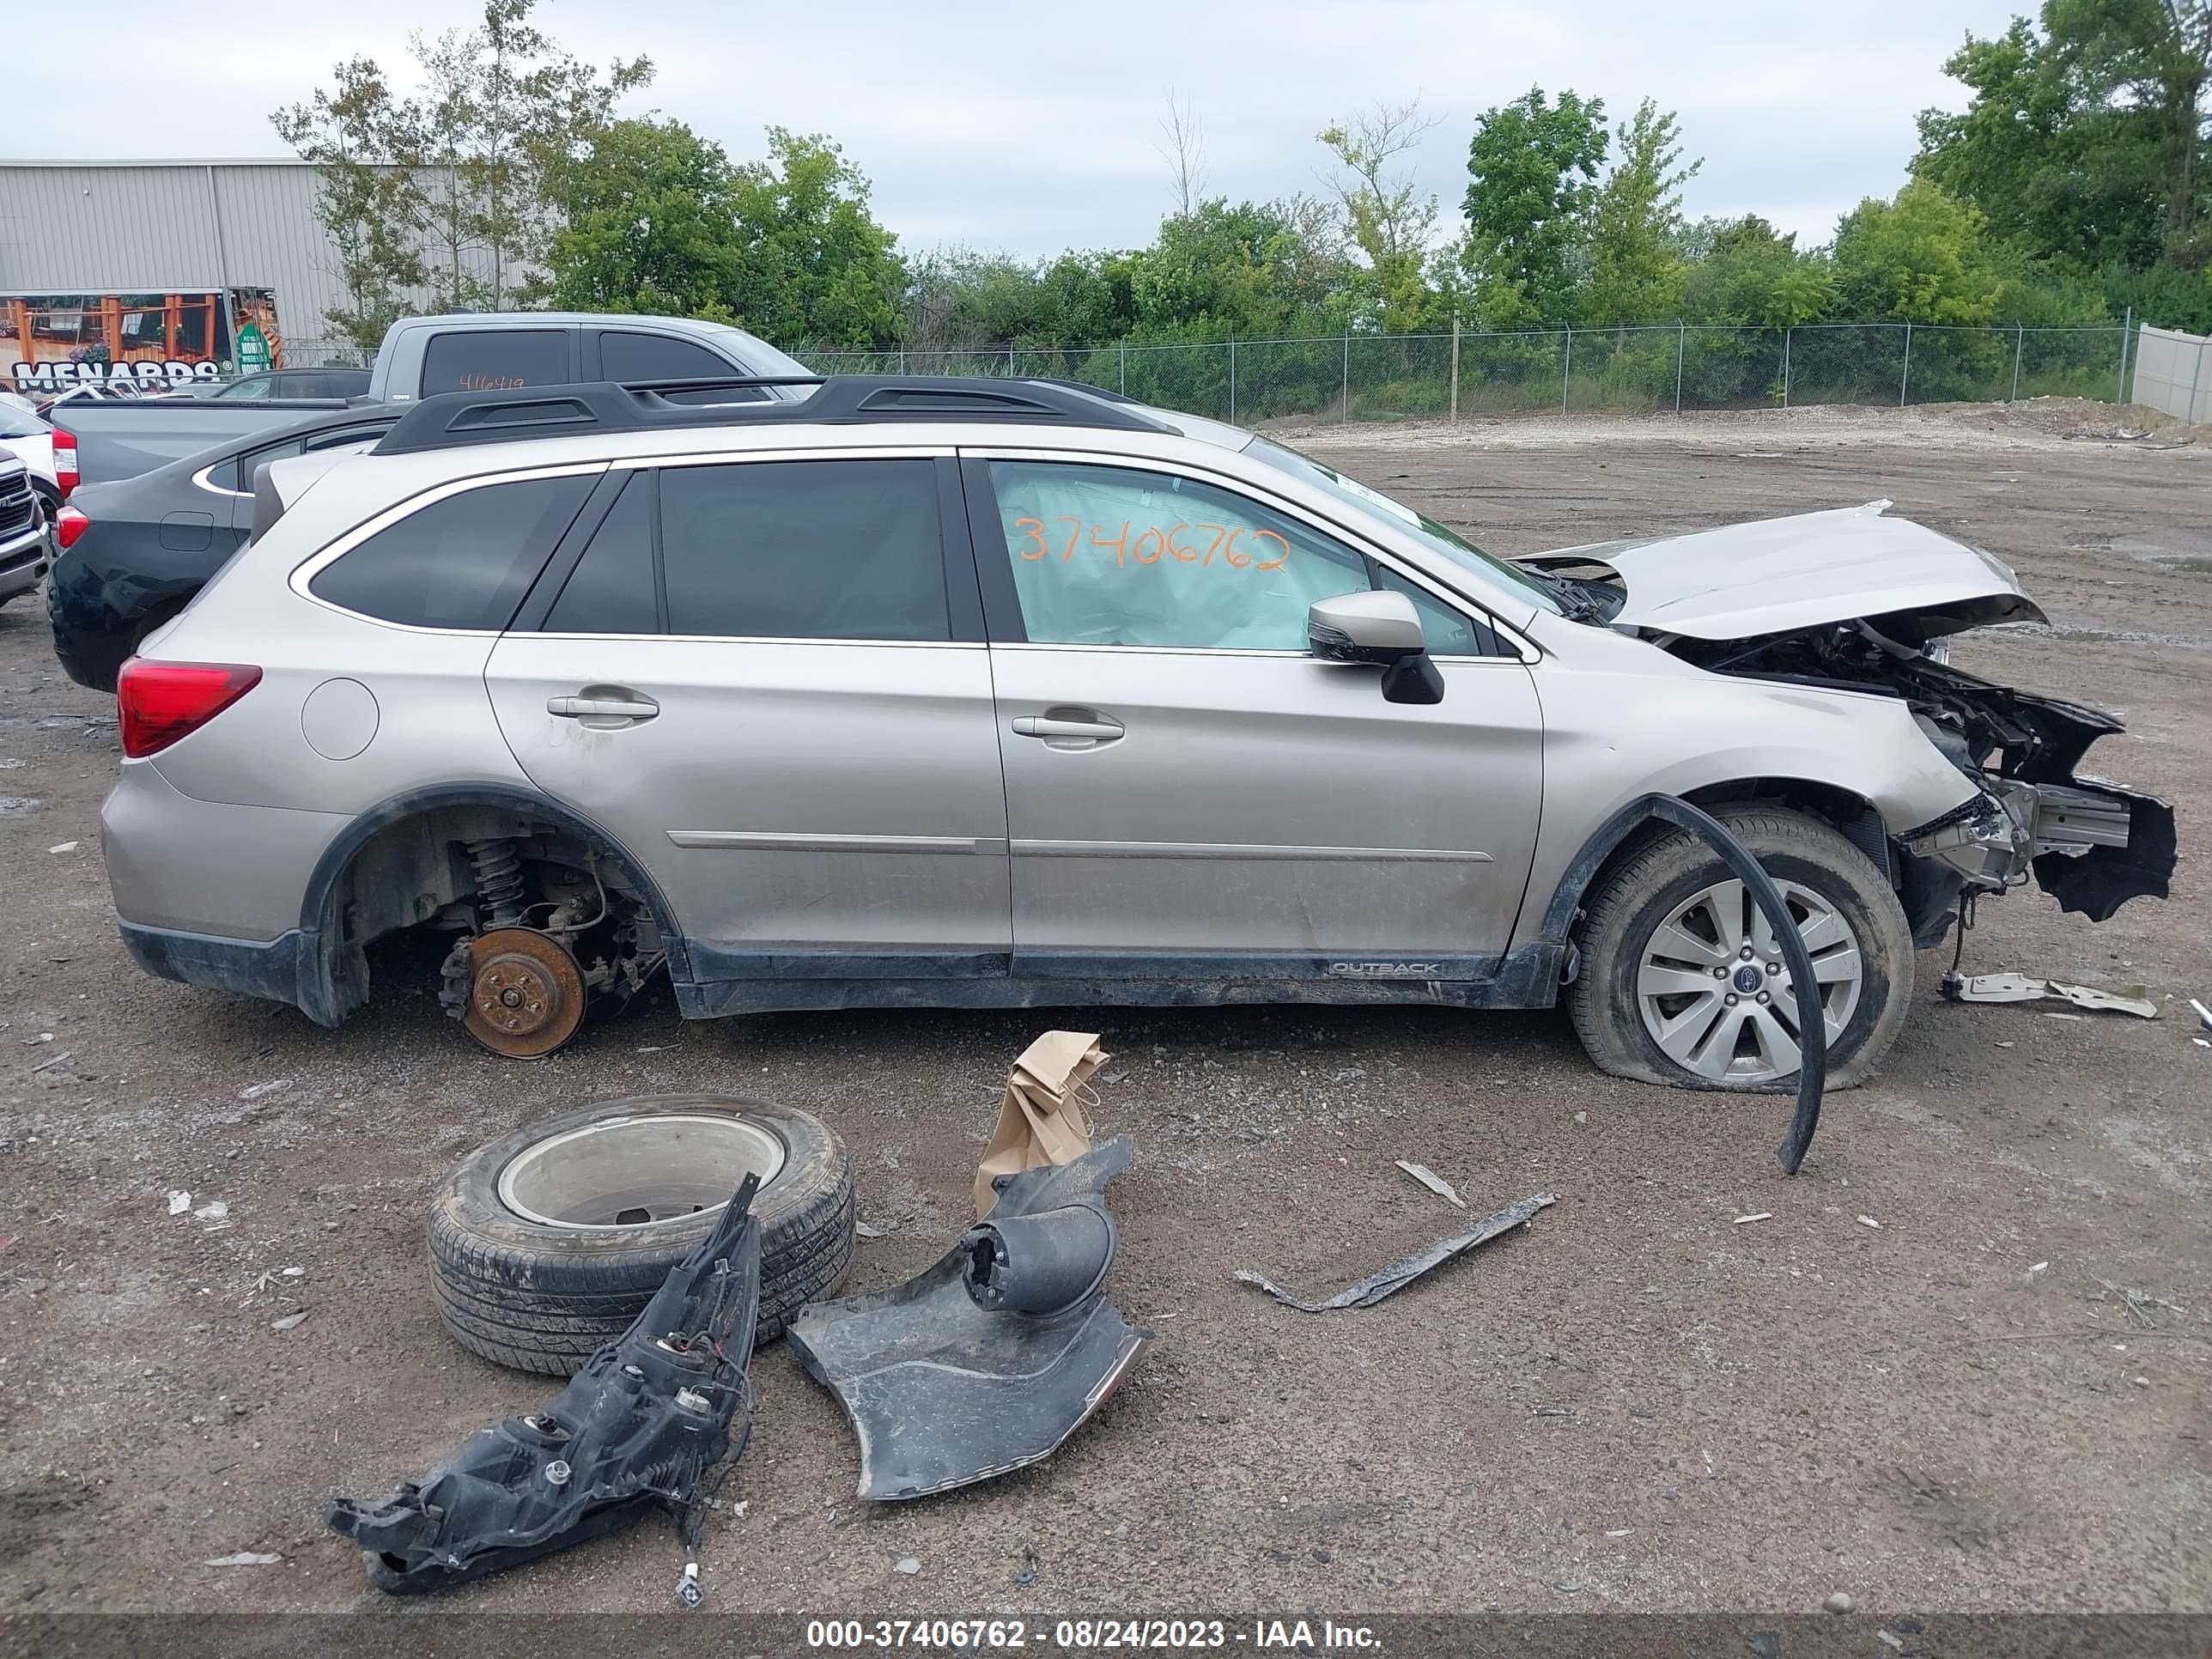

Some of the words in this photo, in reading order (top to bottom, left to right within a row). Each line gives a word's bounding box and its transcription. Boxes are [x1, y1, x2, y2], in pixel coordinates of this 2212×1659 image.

[15, 361, 222, 390] MENARDS
[459, 374, 524, 391] 416419
[1015, 515, 1291, 573] 37406762
[1332, 963, 1440, 973] OUTBACK
